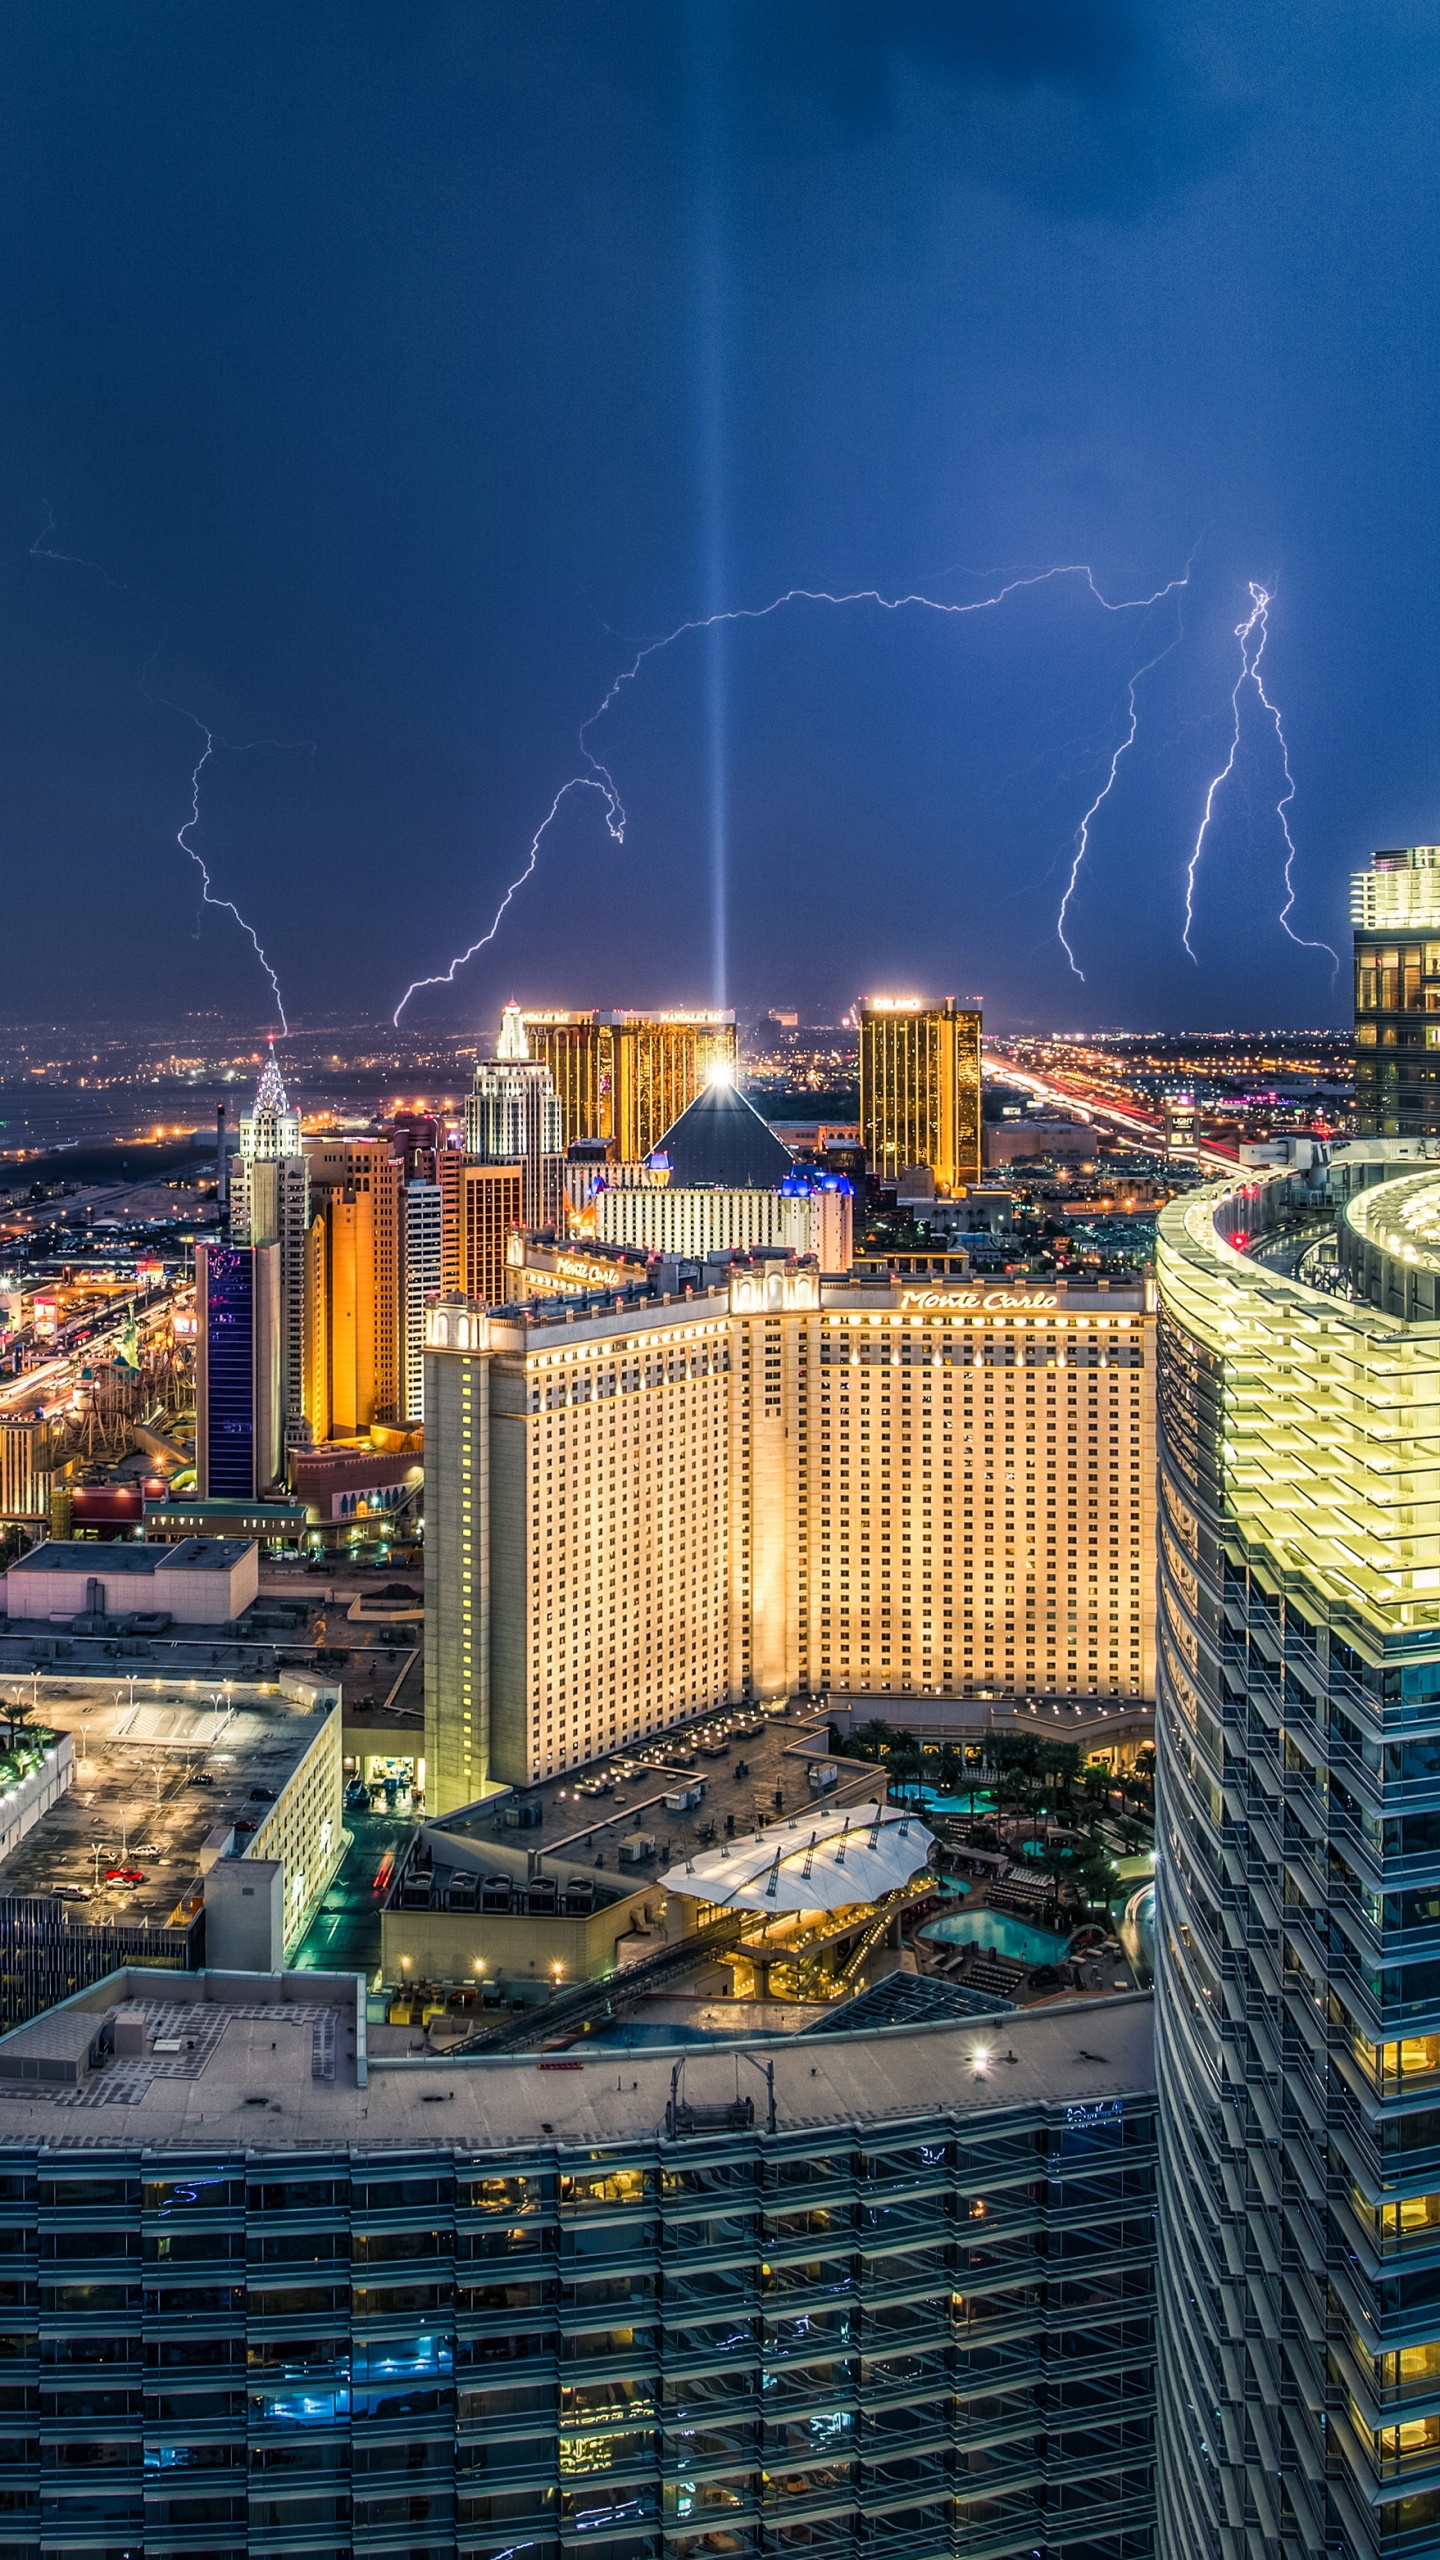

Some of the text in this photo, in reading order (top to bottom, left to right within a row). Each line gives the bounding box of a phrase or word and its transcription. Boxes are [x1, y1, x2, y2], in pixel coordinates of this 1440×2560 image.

[874, 999, 920, 1010] DELANO
[519, 1013, 570, 1022] ANDALAY BAY
[660, 1013, 724, 1022] MANDALAY BAY
[557, 1257, 619, 1285] Monte Carlo
[901, 1291, 1058, 1310] Monte Carlo
